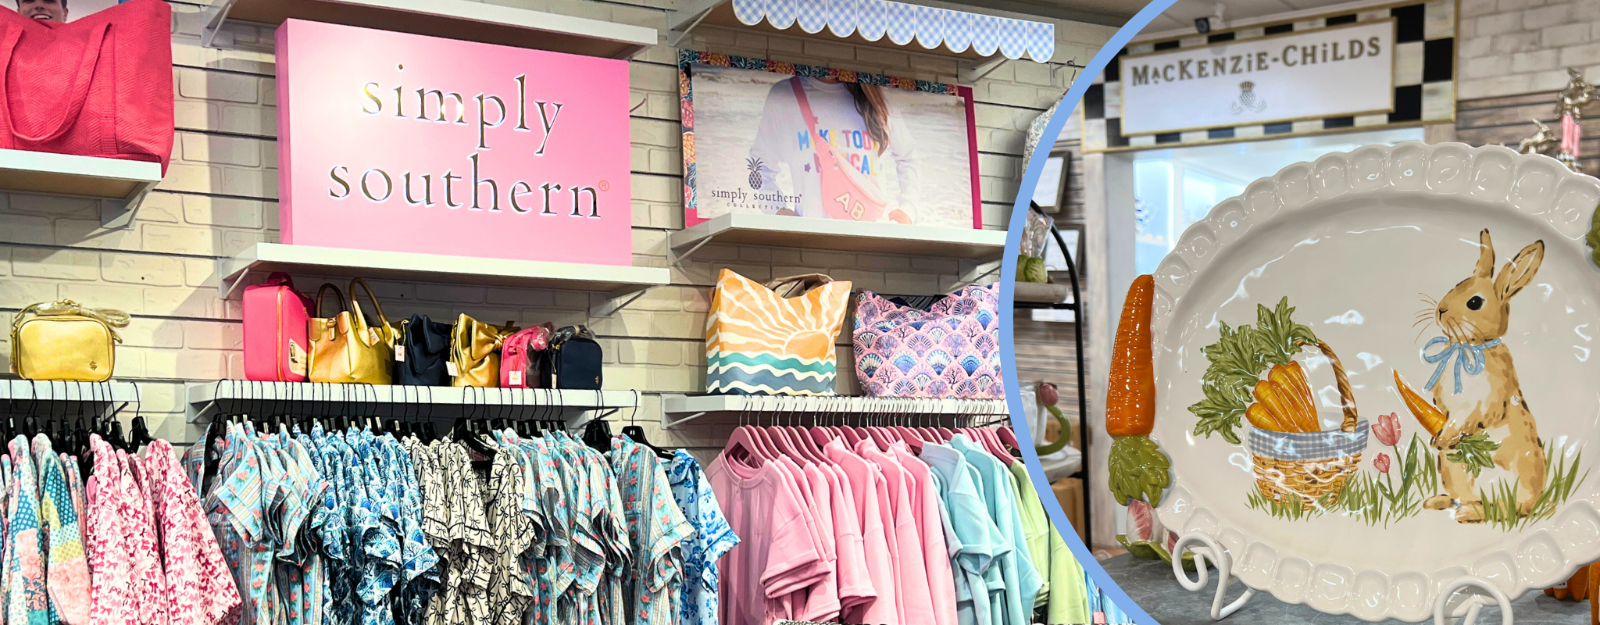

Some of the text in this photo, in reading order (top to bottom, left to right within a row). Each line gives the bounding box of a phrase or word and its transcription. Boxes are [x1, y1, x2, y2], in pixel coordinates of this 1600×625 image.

[361, 63, 564, 155] simply
[797, 129, 880, 151] MKE TOD
[711, 187, 748, 203] simply
[834, 192, 866, 222] AB
